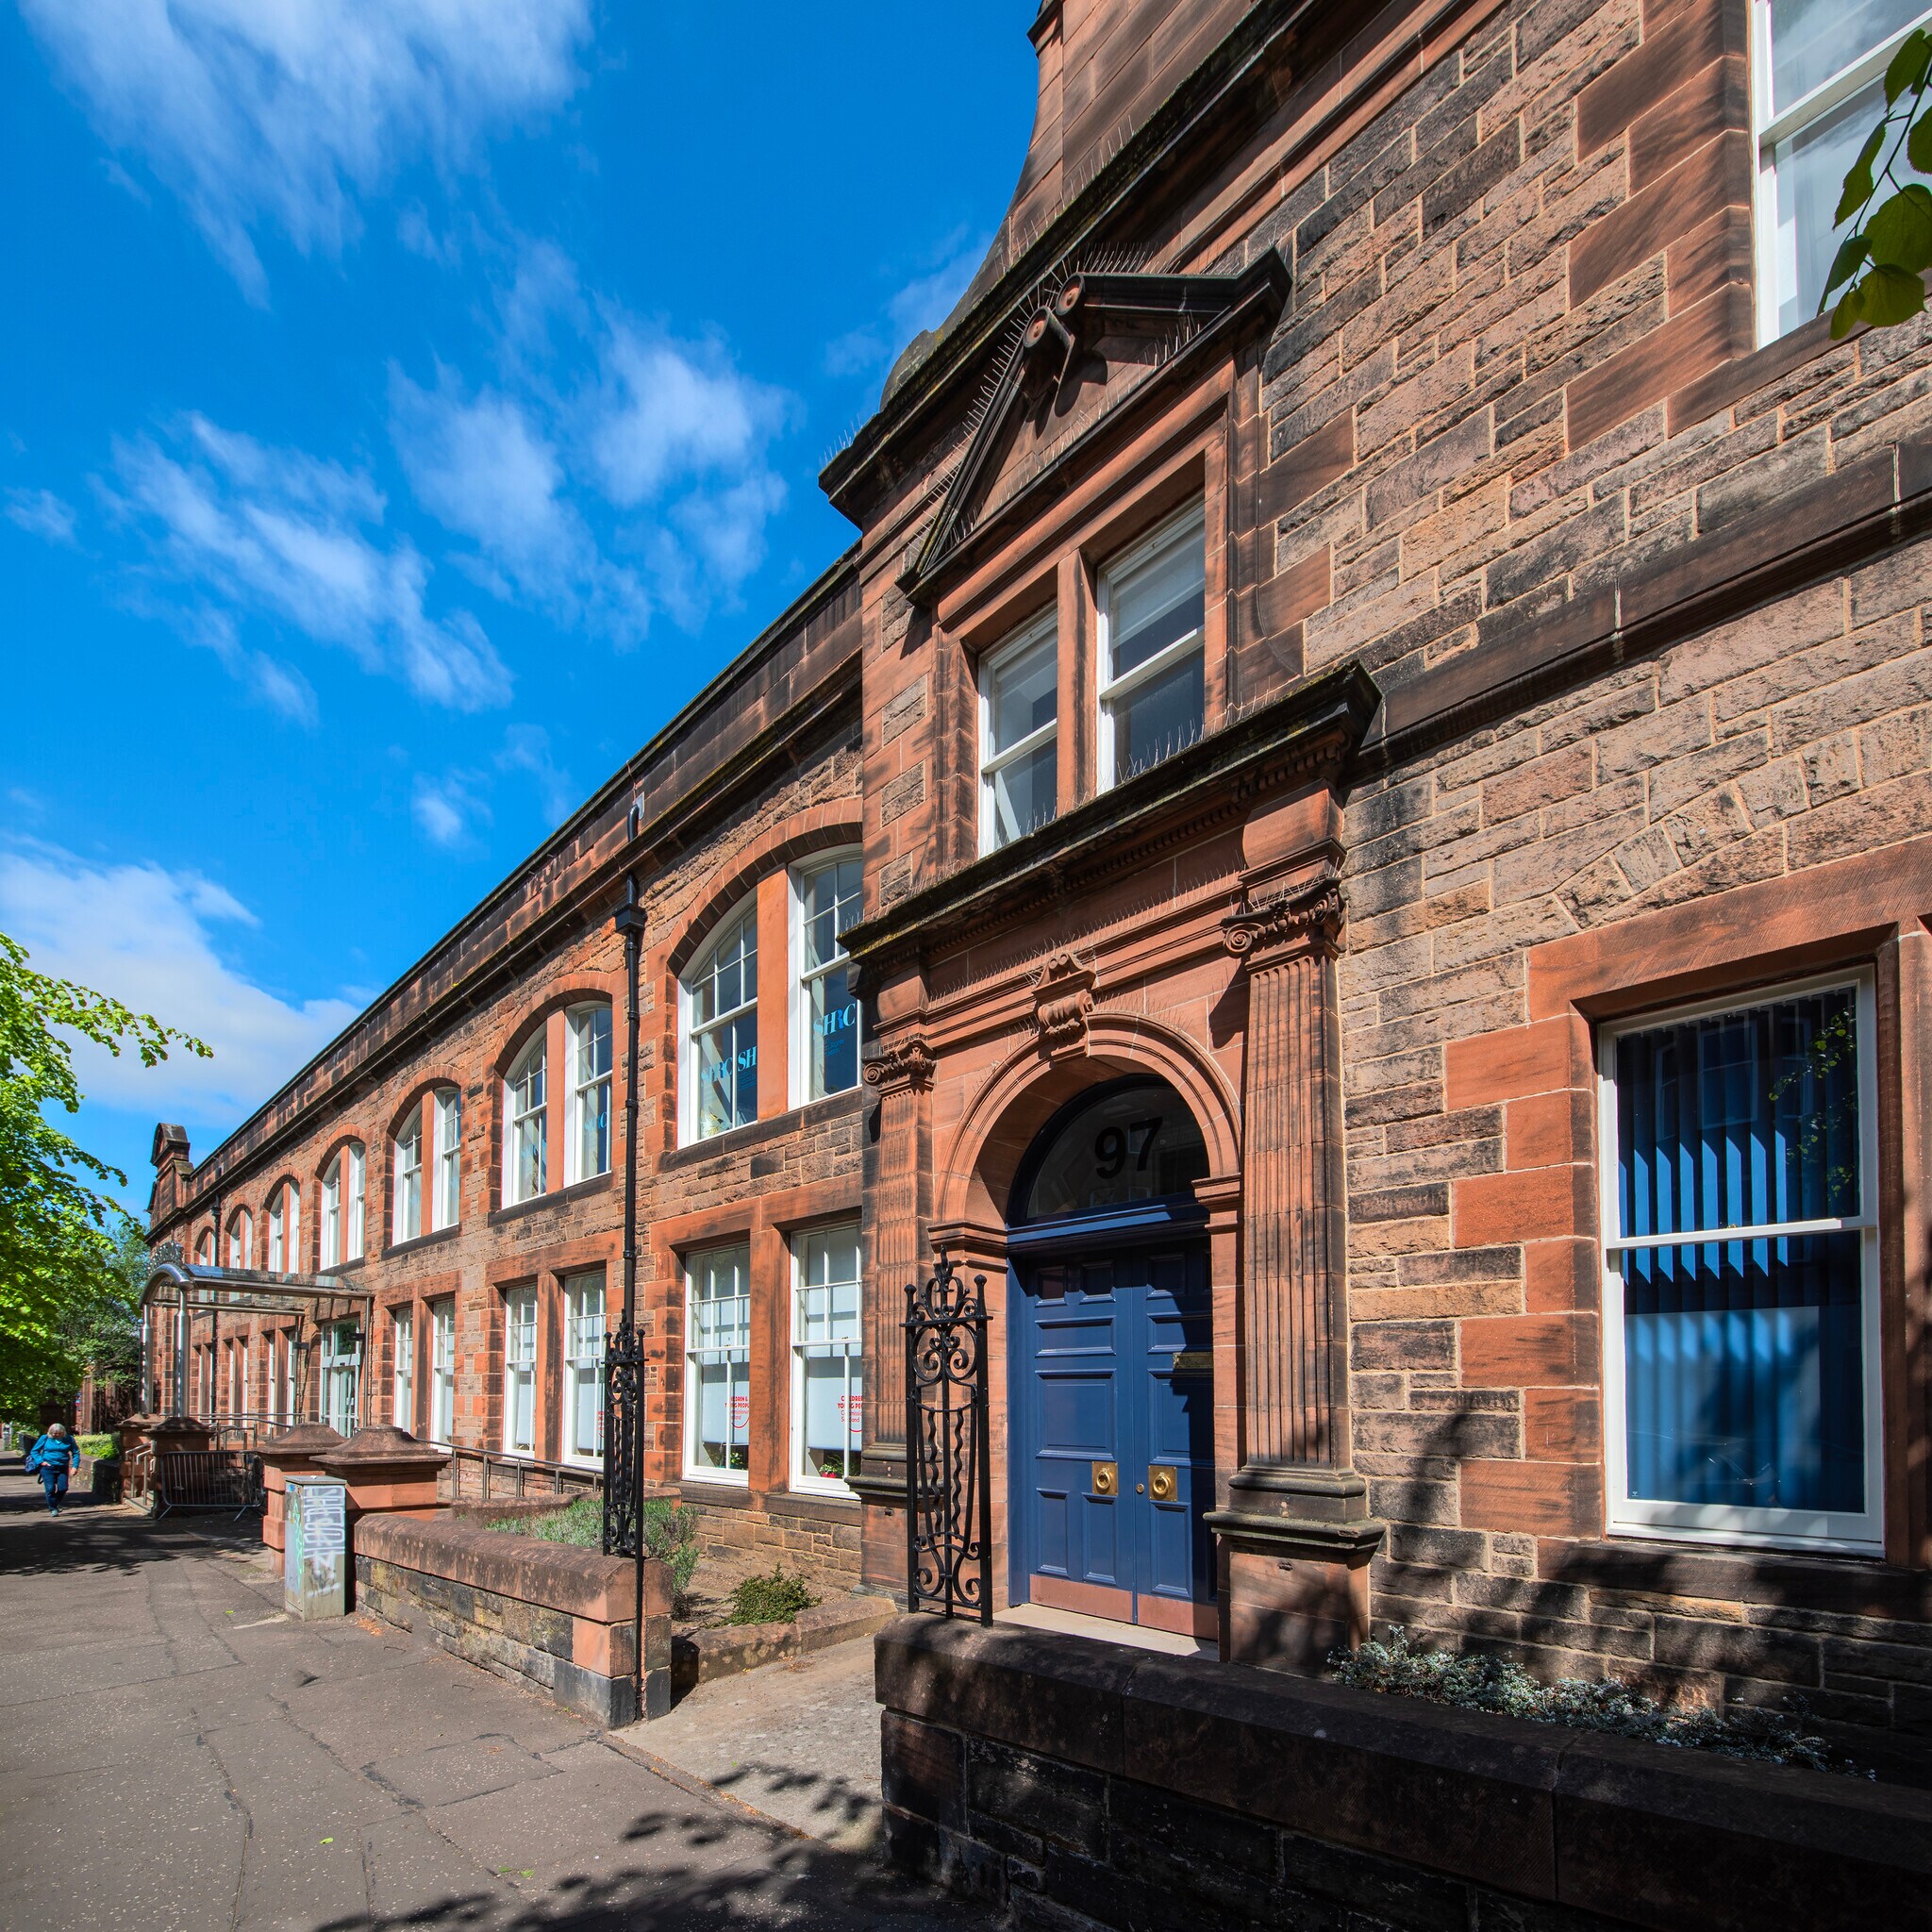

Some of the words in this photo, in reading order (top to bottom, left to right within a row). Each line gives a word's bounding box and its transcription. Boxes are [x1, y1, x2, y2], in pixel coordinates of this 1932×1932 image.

[813, 1003, 856, 1040] SHRC
[738, 1046, 757, 1072] SH
[1095, 1117, 1163, 1179] 97
